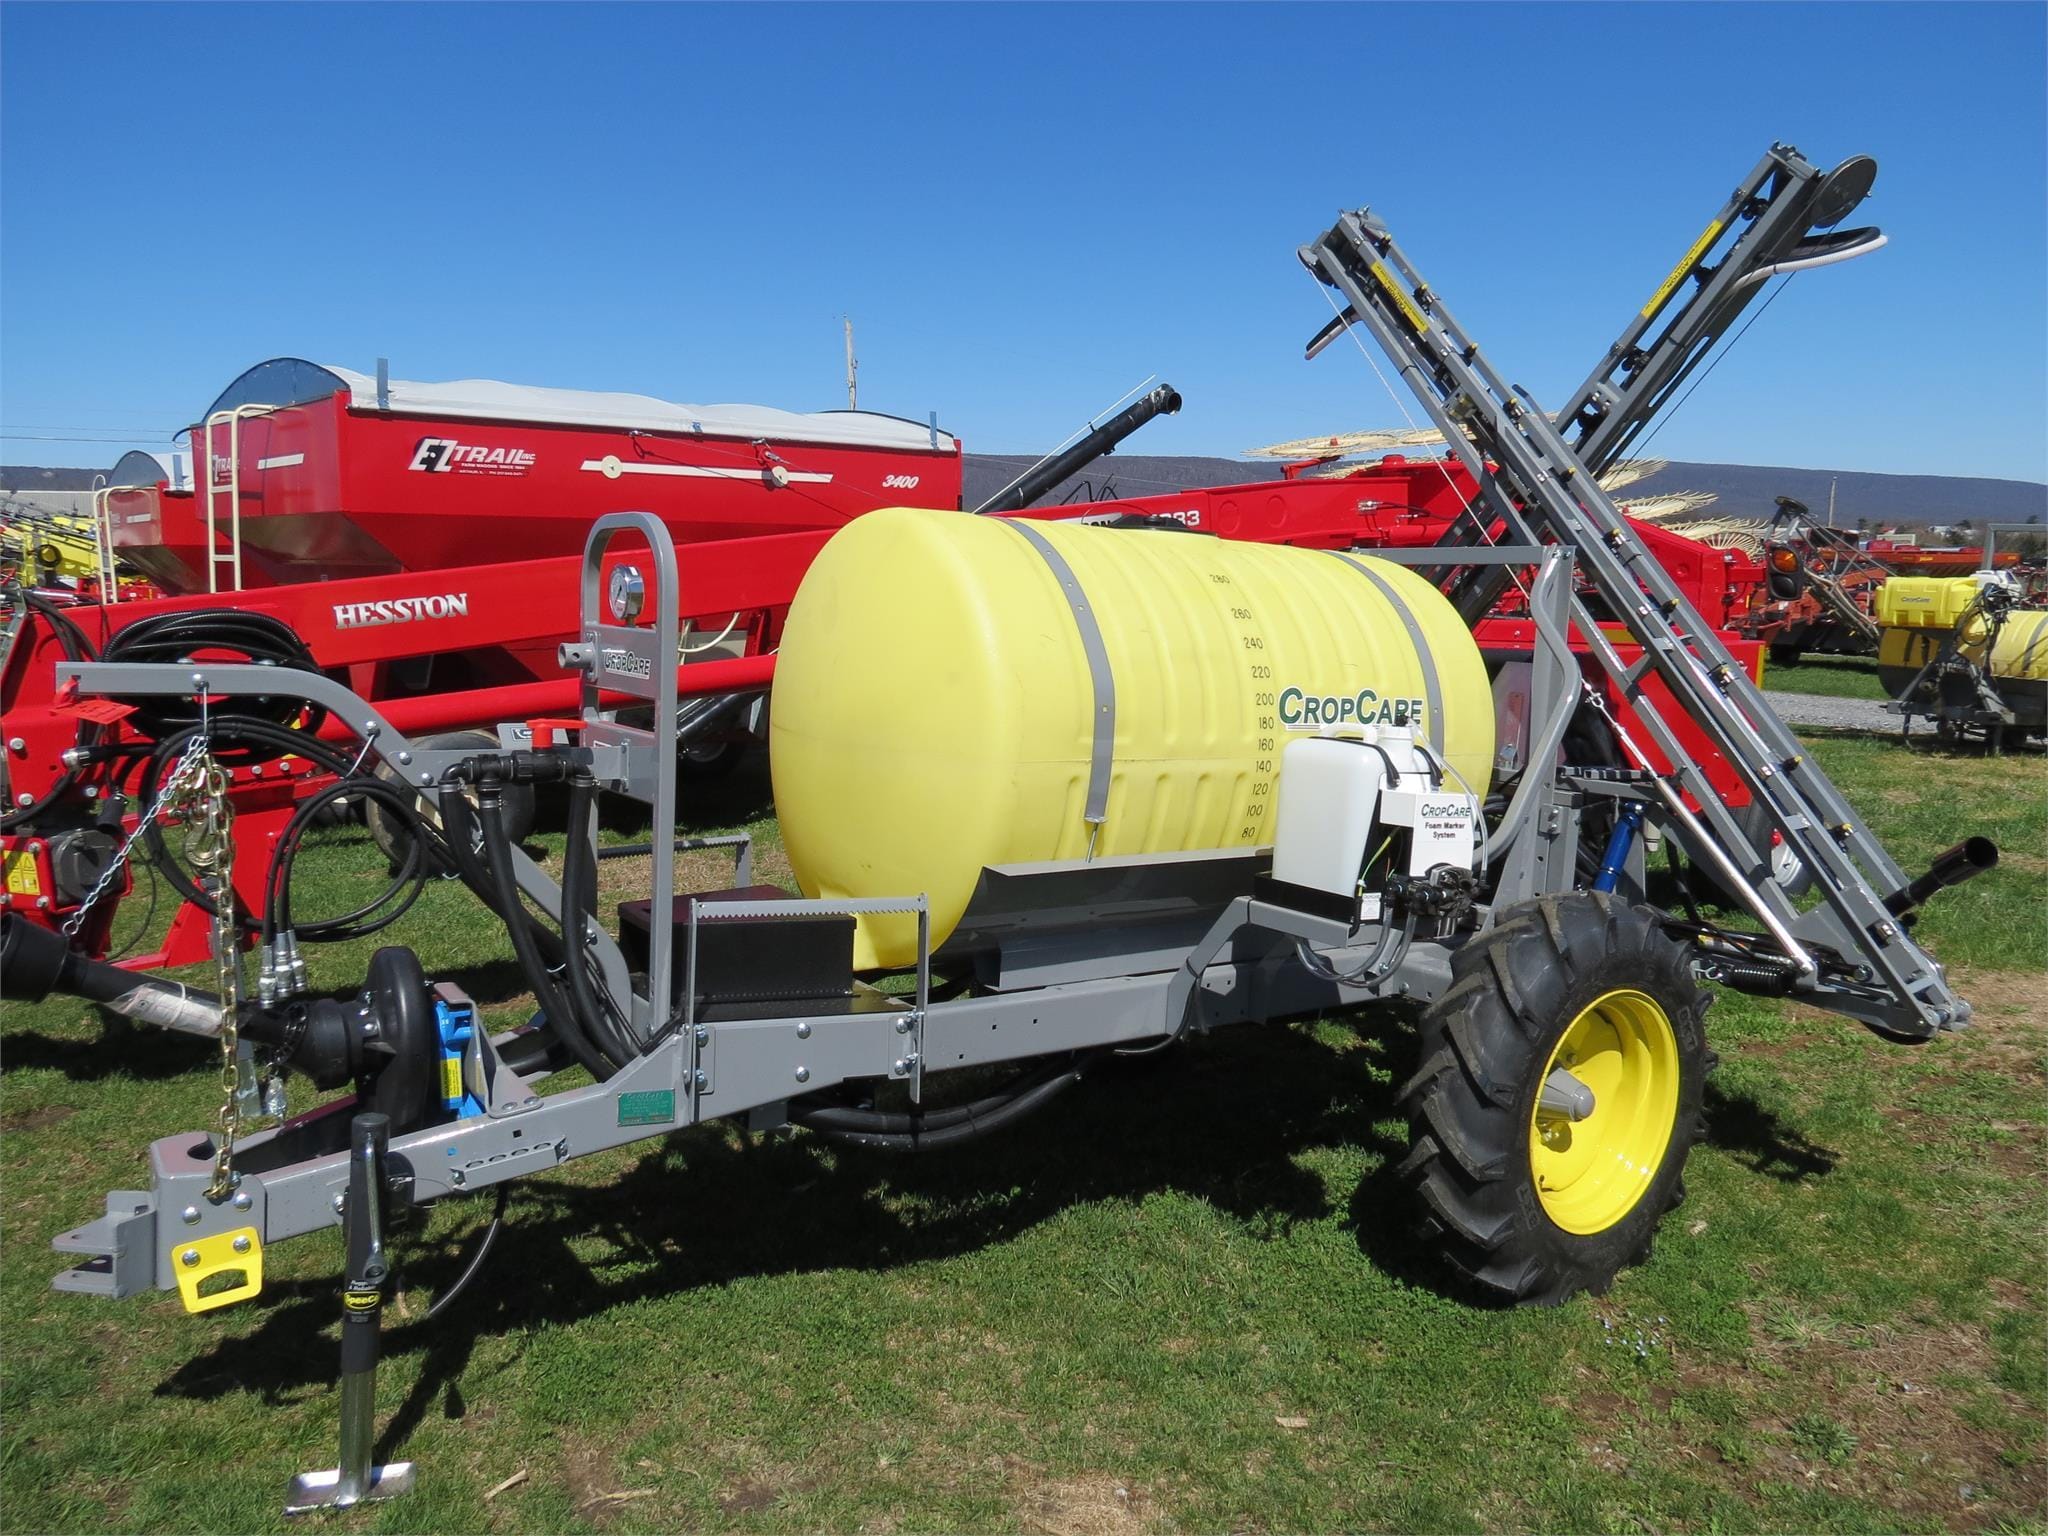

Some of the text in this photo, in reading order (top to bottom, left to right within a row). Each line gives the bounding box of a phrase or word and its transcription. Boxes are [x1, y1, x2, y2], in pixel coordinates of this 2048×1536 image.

[1666, 256, 1693, 288] CAUTION
[1385, 285, 1406, 309] CAUTION
[453, 446, 535, 465] TRAIL
[882, 474, 920, 489] 3400
[1209, 574, 1230, 584] 280
[333, 592, 468, 630] HESSTON
[1243, 636, 1263, 650] 240
[1251, 665, 1270, 679] 220
[1256, 692, 1274, 706] 200
[1258, 716, 1275, 730] 180
[1258, 738, 1274, 751] 160
[1255, 760, 1272, 773] 140
[1252, 782, 1269, 796] 120
[1246, 804, 1263, 817] 100
[1241, 826, 1256, 839] 80
[1424, 822, 1465, 830] Foam Marker
[1432, 831, 1456, 841] System
